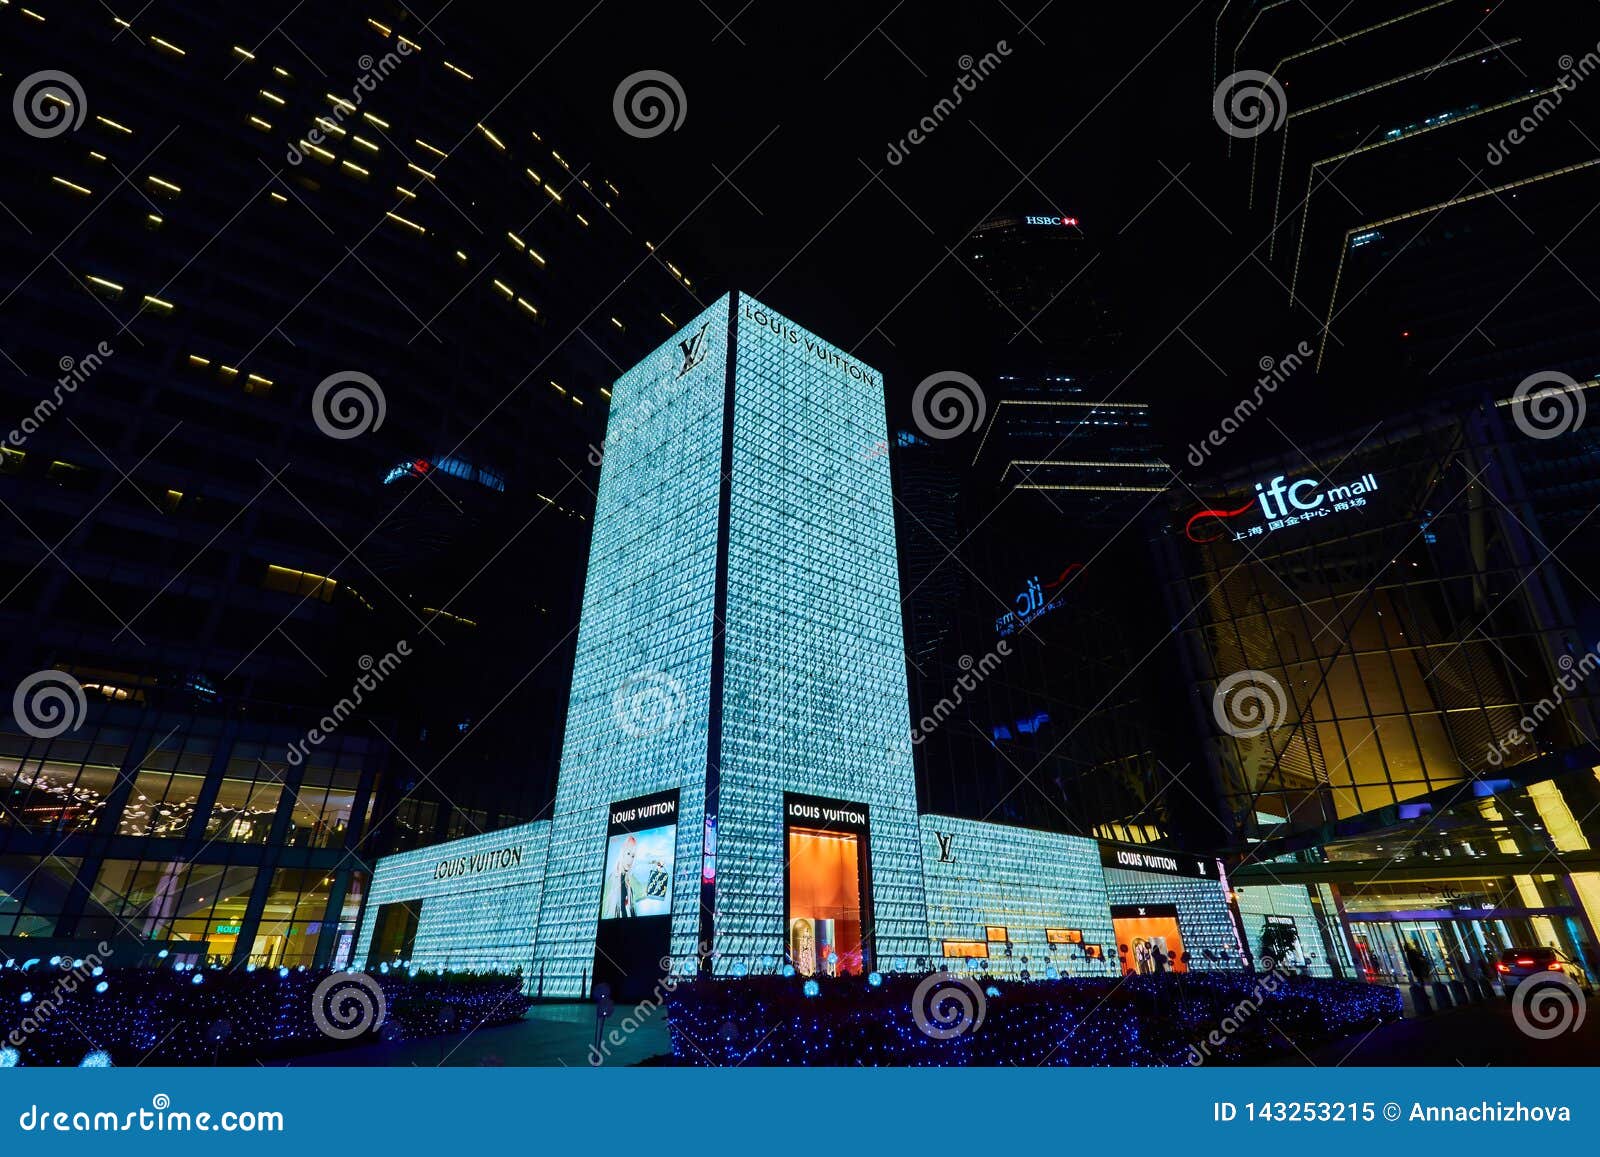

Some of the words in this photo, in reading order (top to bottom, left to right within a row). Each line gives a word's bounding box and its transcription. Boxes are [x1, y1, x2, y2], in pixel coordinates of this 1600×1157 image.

[1026, 216, 1061, 225] HSBC
[745, 305, 798, 344] LOUIS
[804, 338, 875, 388] VUITTON
[1255, 476, 1324, 519] ifc
[1327, 473, 1378, 502] mall
[612, 809, 636, 824] LOUIS
[638, 801, 675, 819] VUITTON
[789, 804, 820, 819] LOUIS
[823, 808, 865, 825] VUITTON
[433, 857, 466, 879] LOUIS
[470, 846, 522, 873] VUITTON
[1117, 851, 1142, 866] LOUIS
[1142, 855, 1178, 871] VUITTON
